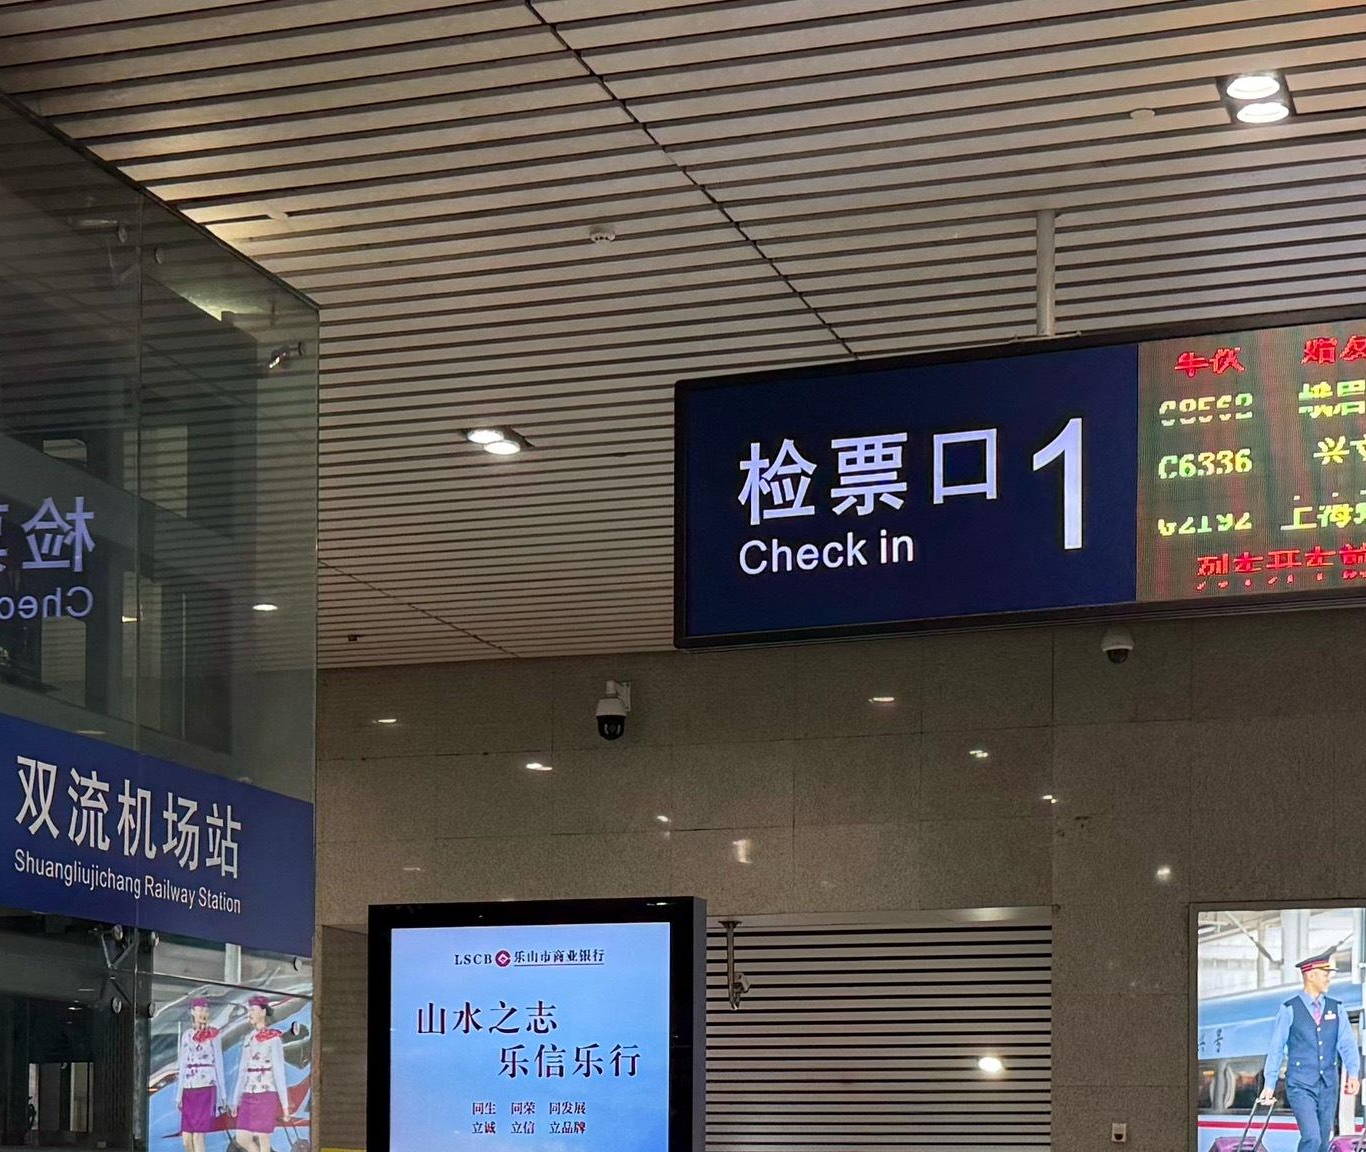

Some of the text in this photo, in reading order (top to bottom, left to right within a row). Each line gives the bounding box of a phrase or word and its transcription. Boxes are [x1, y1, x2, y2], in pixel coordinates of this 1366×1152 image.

[1159, 449, 1253, 480] C6336
[738, 417, 1083, 551] 检票口 1
[739, 529, 914, 576] Check in
[15, 755, 242, 880] 双流机场站
[14, 848, 242, 915] Shuangliujichang Railway Station
[455, 949, 605, 966] LSCB 乐山市商业银行
[416, 1000, 559, 1035] 山水之志
[498, 1043, 641, 1079] 乐信乐行
[510, 1121, 535, 1135] 立信
